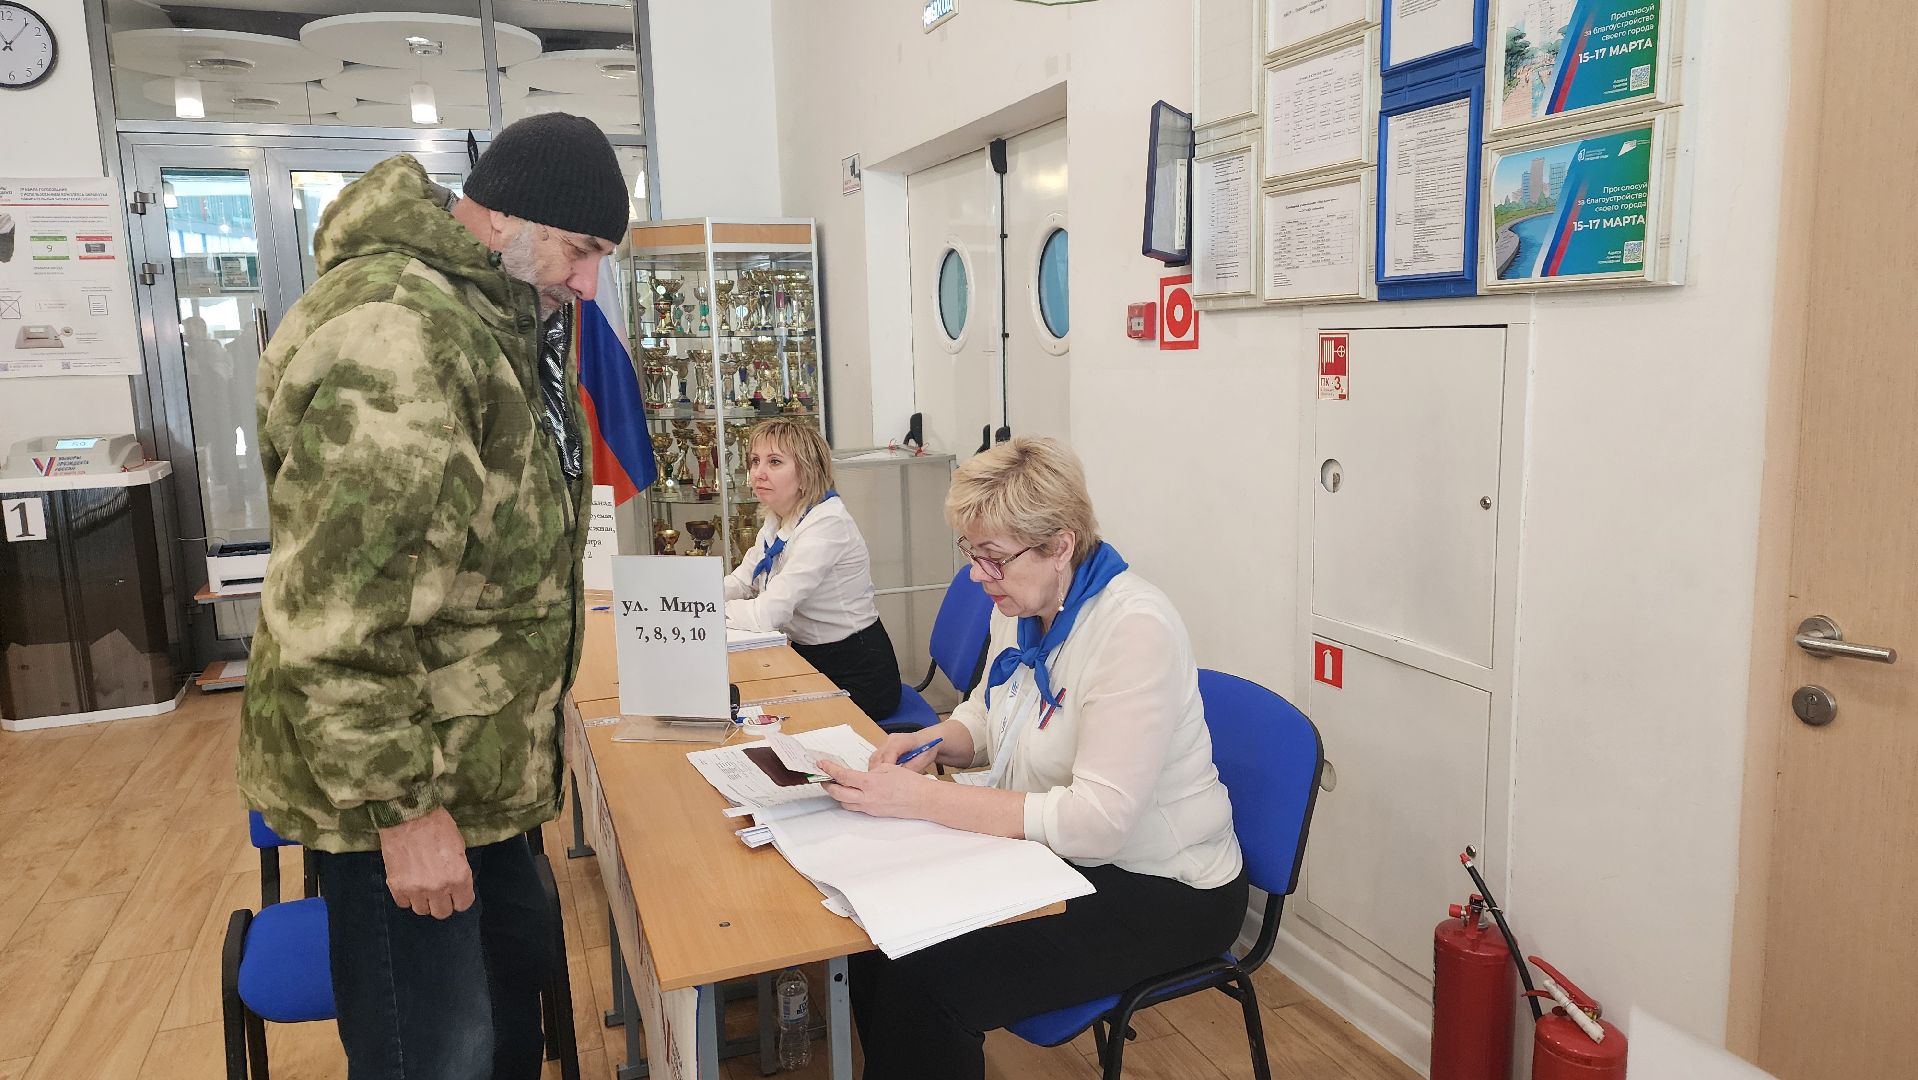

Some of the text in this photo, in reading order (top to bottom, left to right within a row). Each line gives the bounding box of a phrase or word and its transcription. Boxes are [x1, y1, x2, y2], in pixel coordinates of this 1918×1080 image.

[1610, 3, 1655, 21] Проголосуй
[1593, 14, 1655, 35] благоустройство
[34, 26, 42, 37] 2
[1601, 24, 1654, 41] своего города
[41, 43, 47, 52] 3
[1578, 37, 1653, 63] 15-17 МАРТА
[37, 58, 43, 68] 4
[8, 70, 16, 81] 6
[25, 67, 33, 77] 5
[1603, 182, 1648, 194] Проголосуй
[1586, 192, 1648, 205] благоустройство
[1594, 201, 1647, 213] своего города
[1572, 214, 1646, 232] 15-17 МАРТА
[46, 244, 53, 252] 9
[1320, 376, 1341, 391] ПК 3
[10, 501, 36, 538] 1
[586, 539, 602, 548] ира
[621, 596, 717, 619] ул. Мира
[635, 626, 706, 644] 7, 8, 9, 10
